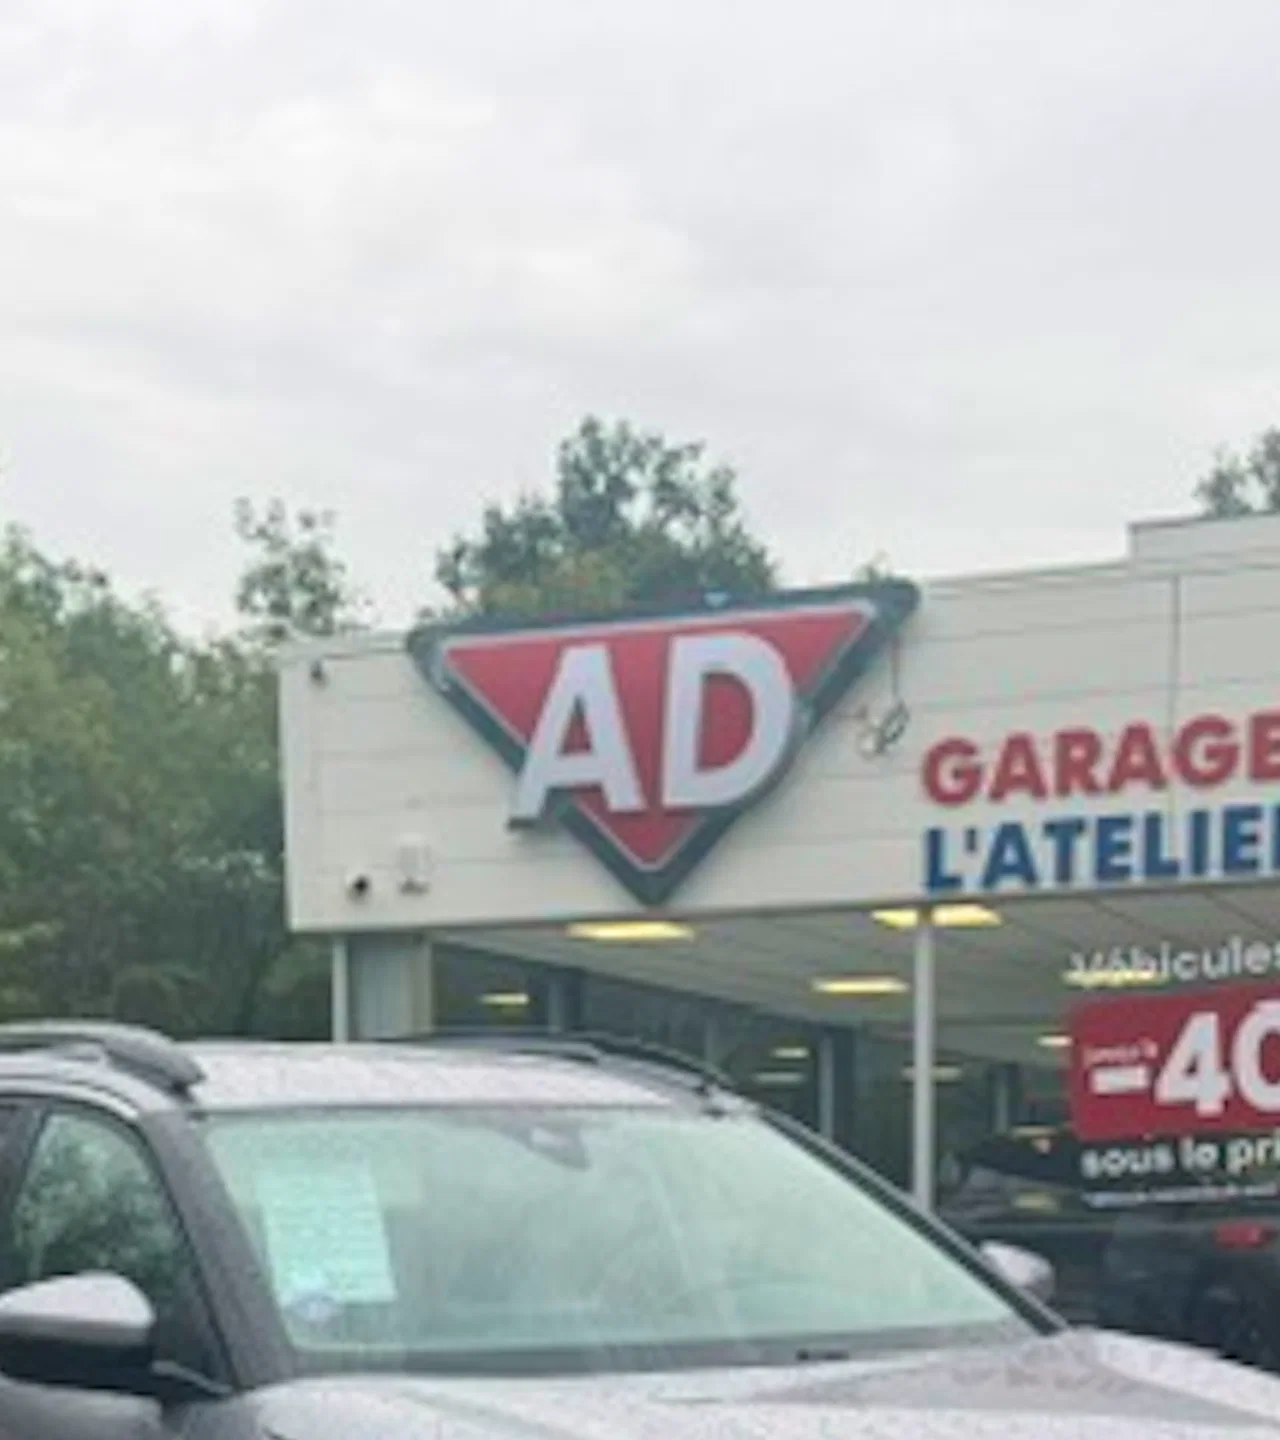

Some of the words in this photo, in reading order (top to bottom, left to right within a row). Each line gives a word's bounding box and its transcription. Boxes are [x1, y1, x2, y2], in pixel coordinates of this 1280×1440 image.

[511, 631, 795, 818] AD
[1081, 1147, 1175, 1179] sous
[1178, 1136, 1219, 1171] le
